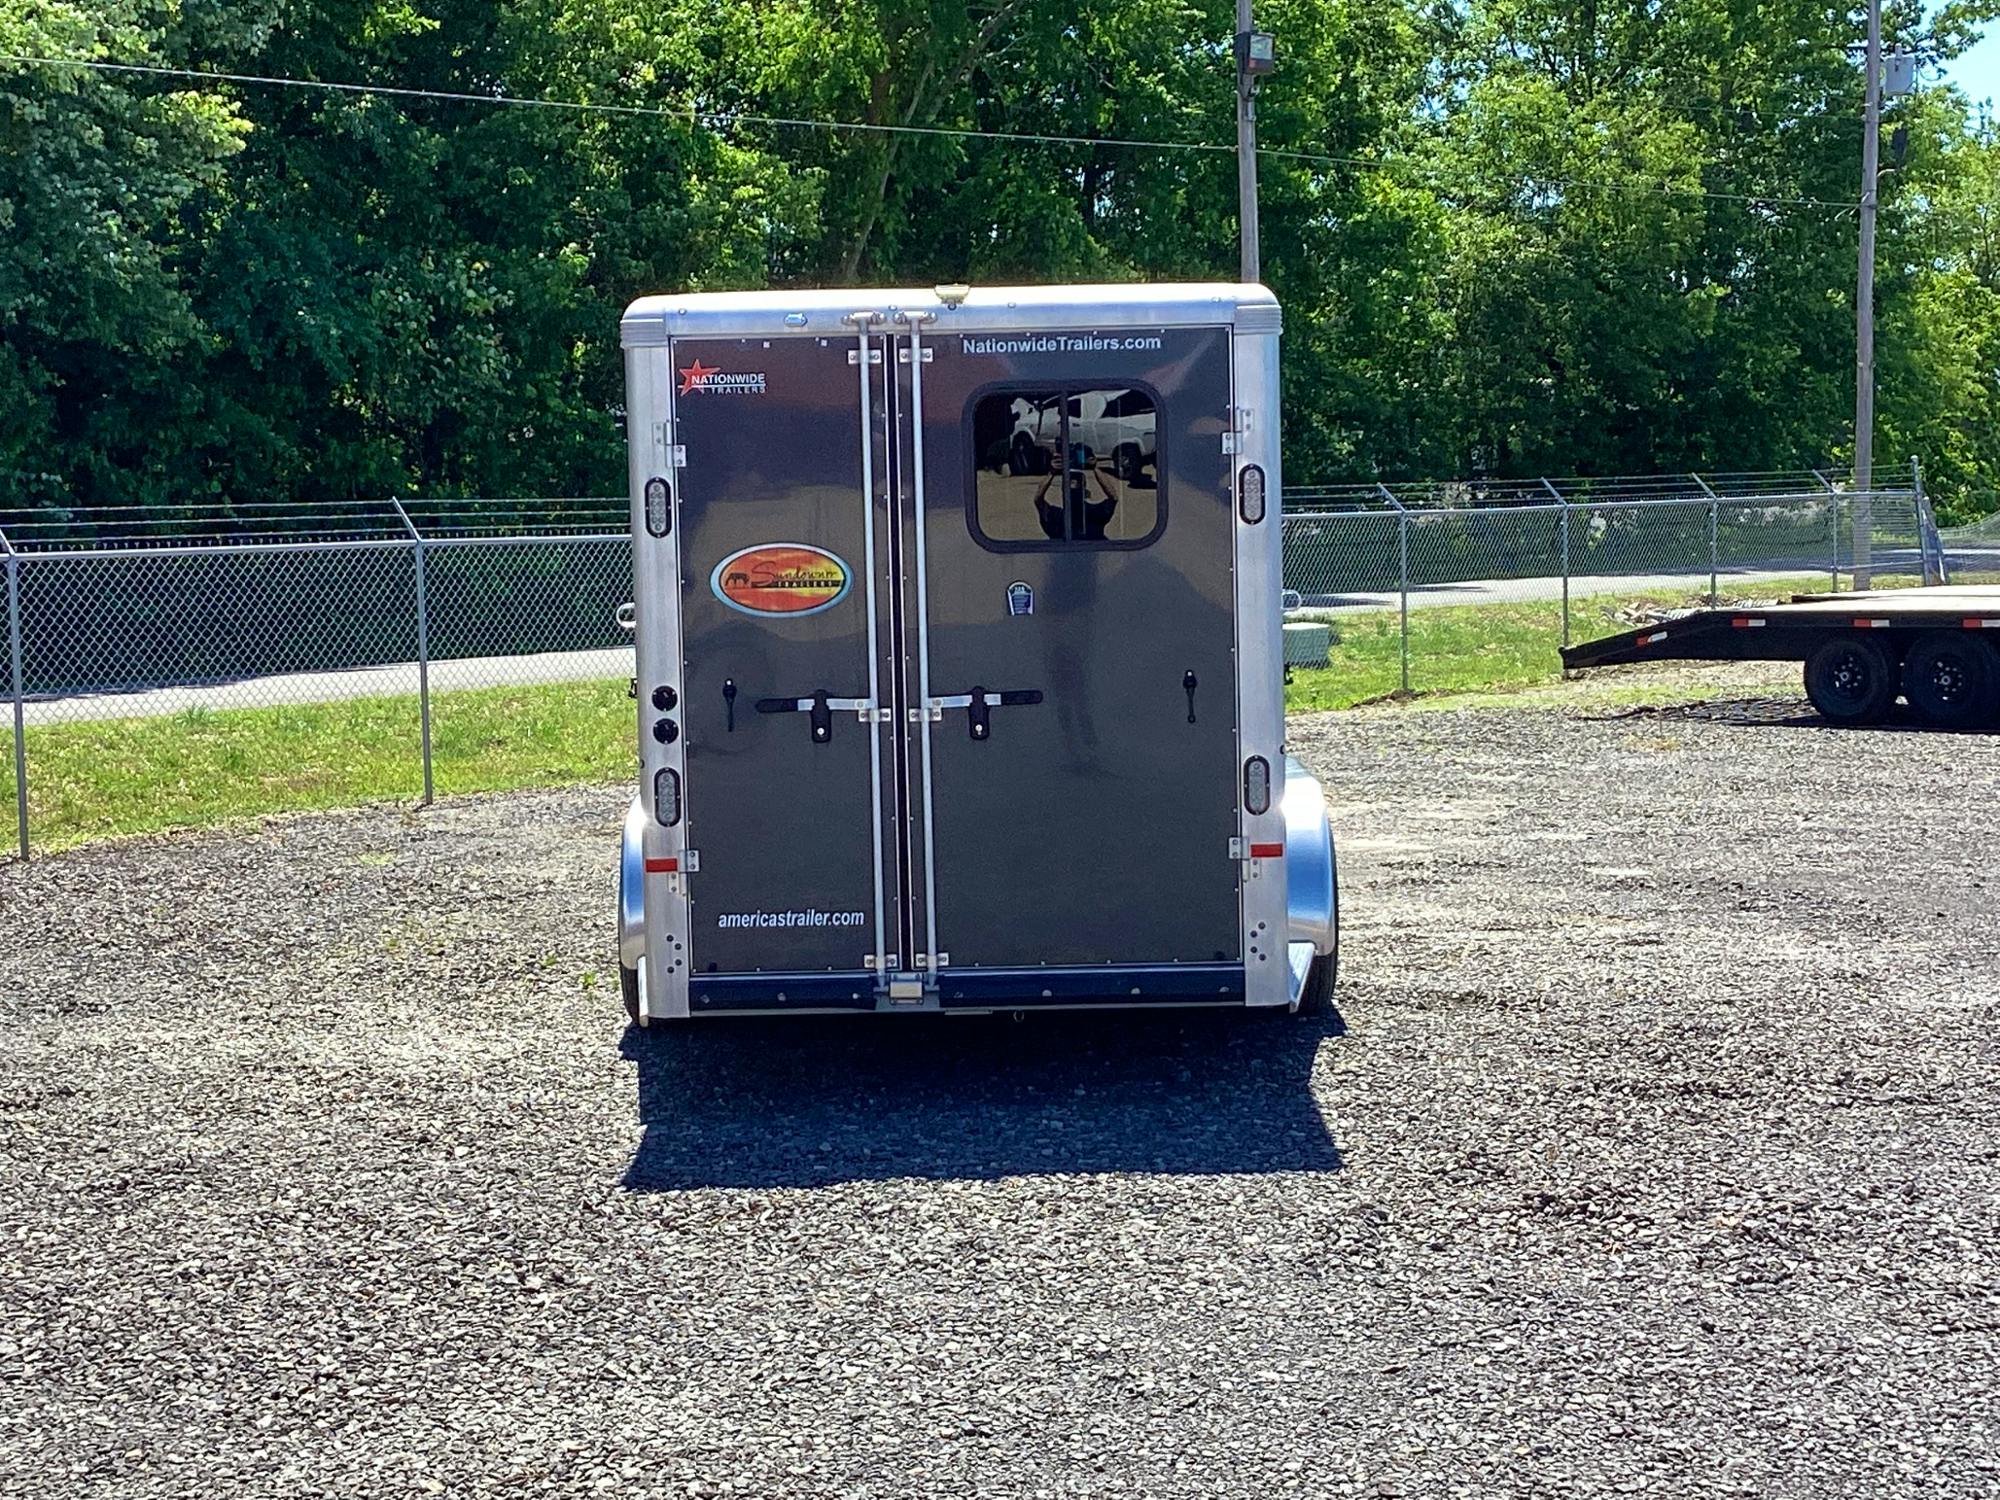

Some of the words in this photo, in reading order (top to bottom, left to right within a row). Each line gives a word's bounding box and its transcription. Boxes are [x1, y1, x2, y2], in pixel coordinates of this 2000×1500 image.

[963, 336, 1161, 354] NationwideTrailers.com
[691, 373, 765, 384] NATIONWIDE
[711, 386, 766, 394] TRAILERS
[718, 909, 864, 927] americastrailer.com
